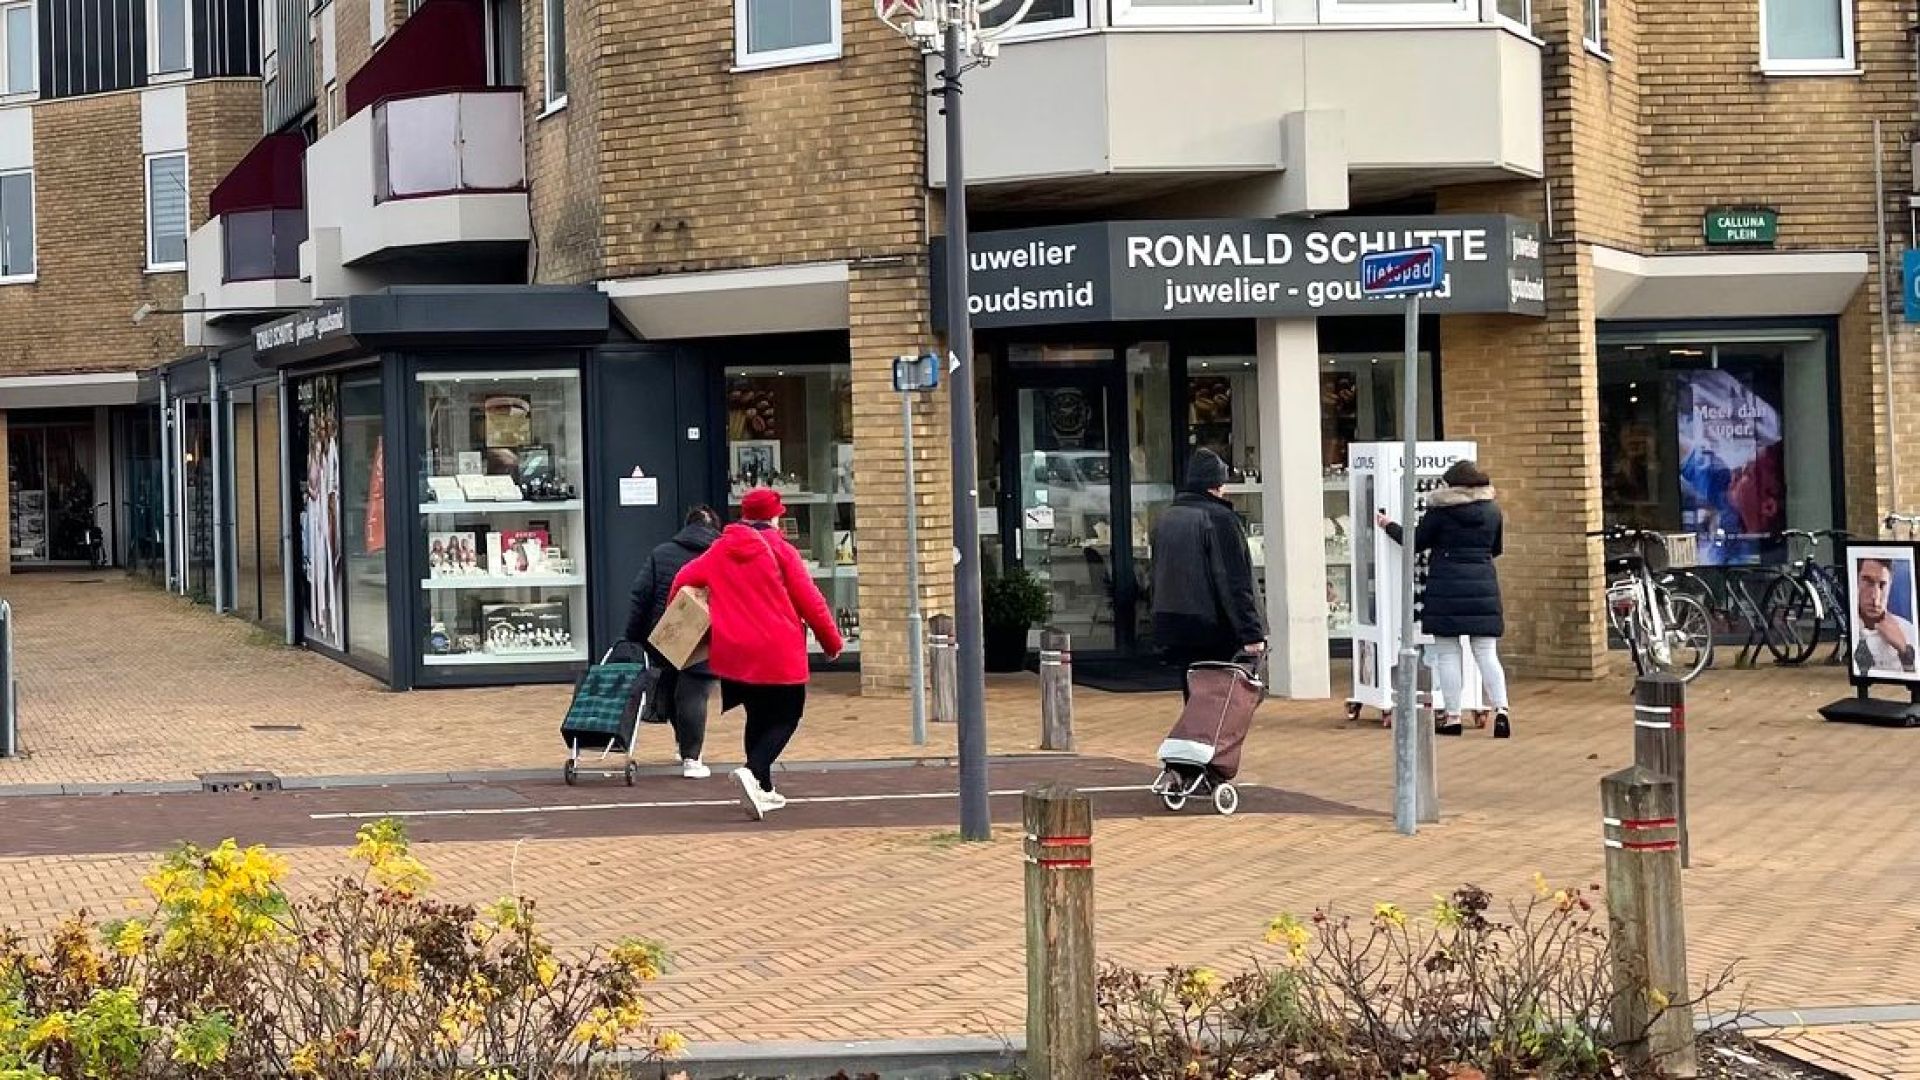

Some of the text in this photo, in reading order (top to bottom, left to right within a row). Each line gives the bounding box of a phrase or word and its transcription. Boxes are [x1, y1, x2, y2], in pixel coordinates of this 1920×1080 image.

[1717, 216, 1766, 228] CALLUNA
[1727, 229, 1757, 240] PLEIN
[969, 241, 1078, 272] uwelier
[1127, 229, 1488, 268] RONALD SCHUTTE
[967, 281, 1094, 315] oudsmid
[1164, 273, 1451, 310] juwelier - goud
[1694, 405, 1734, 420] Meer
[1708, 424, 1754, 441] super.
